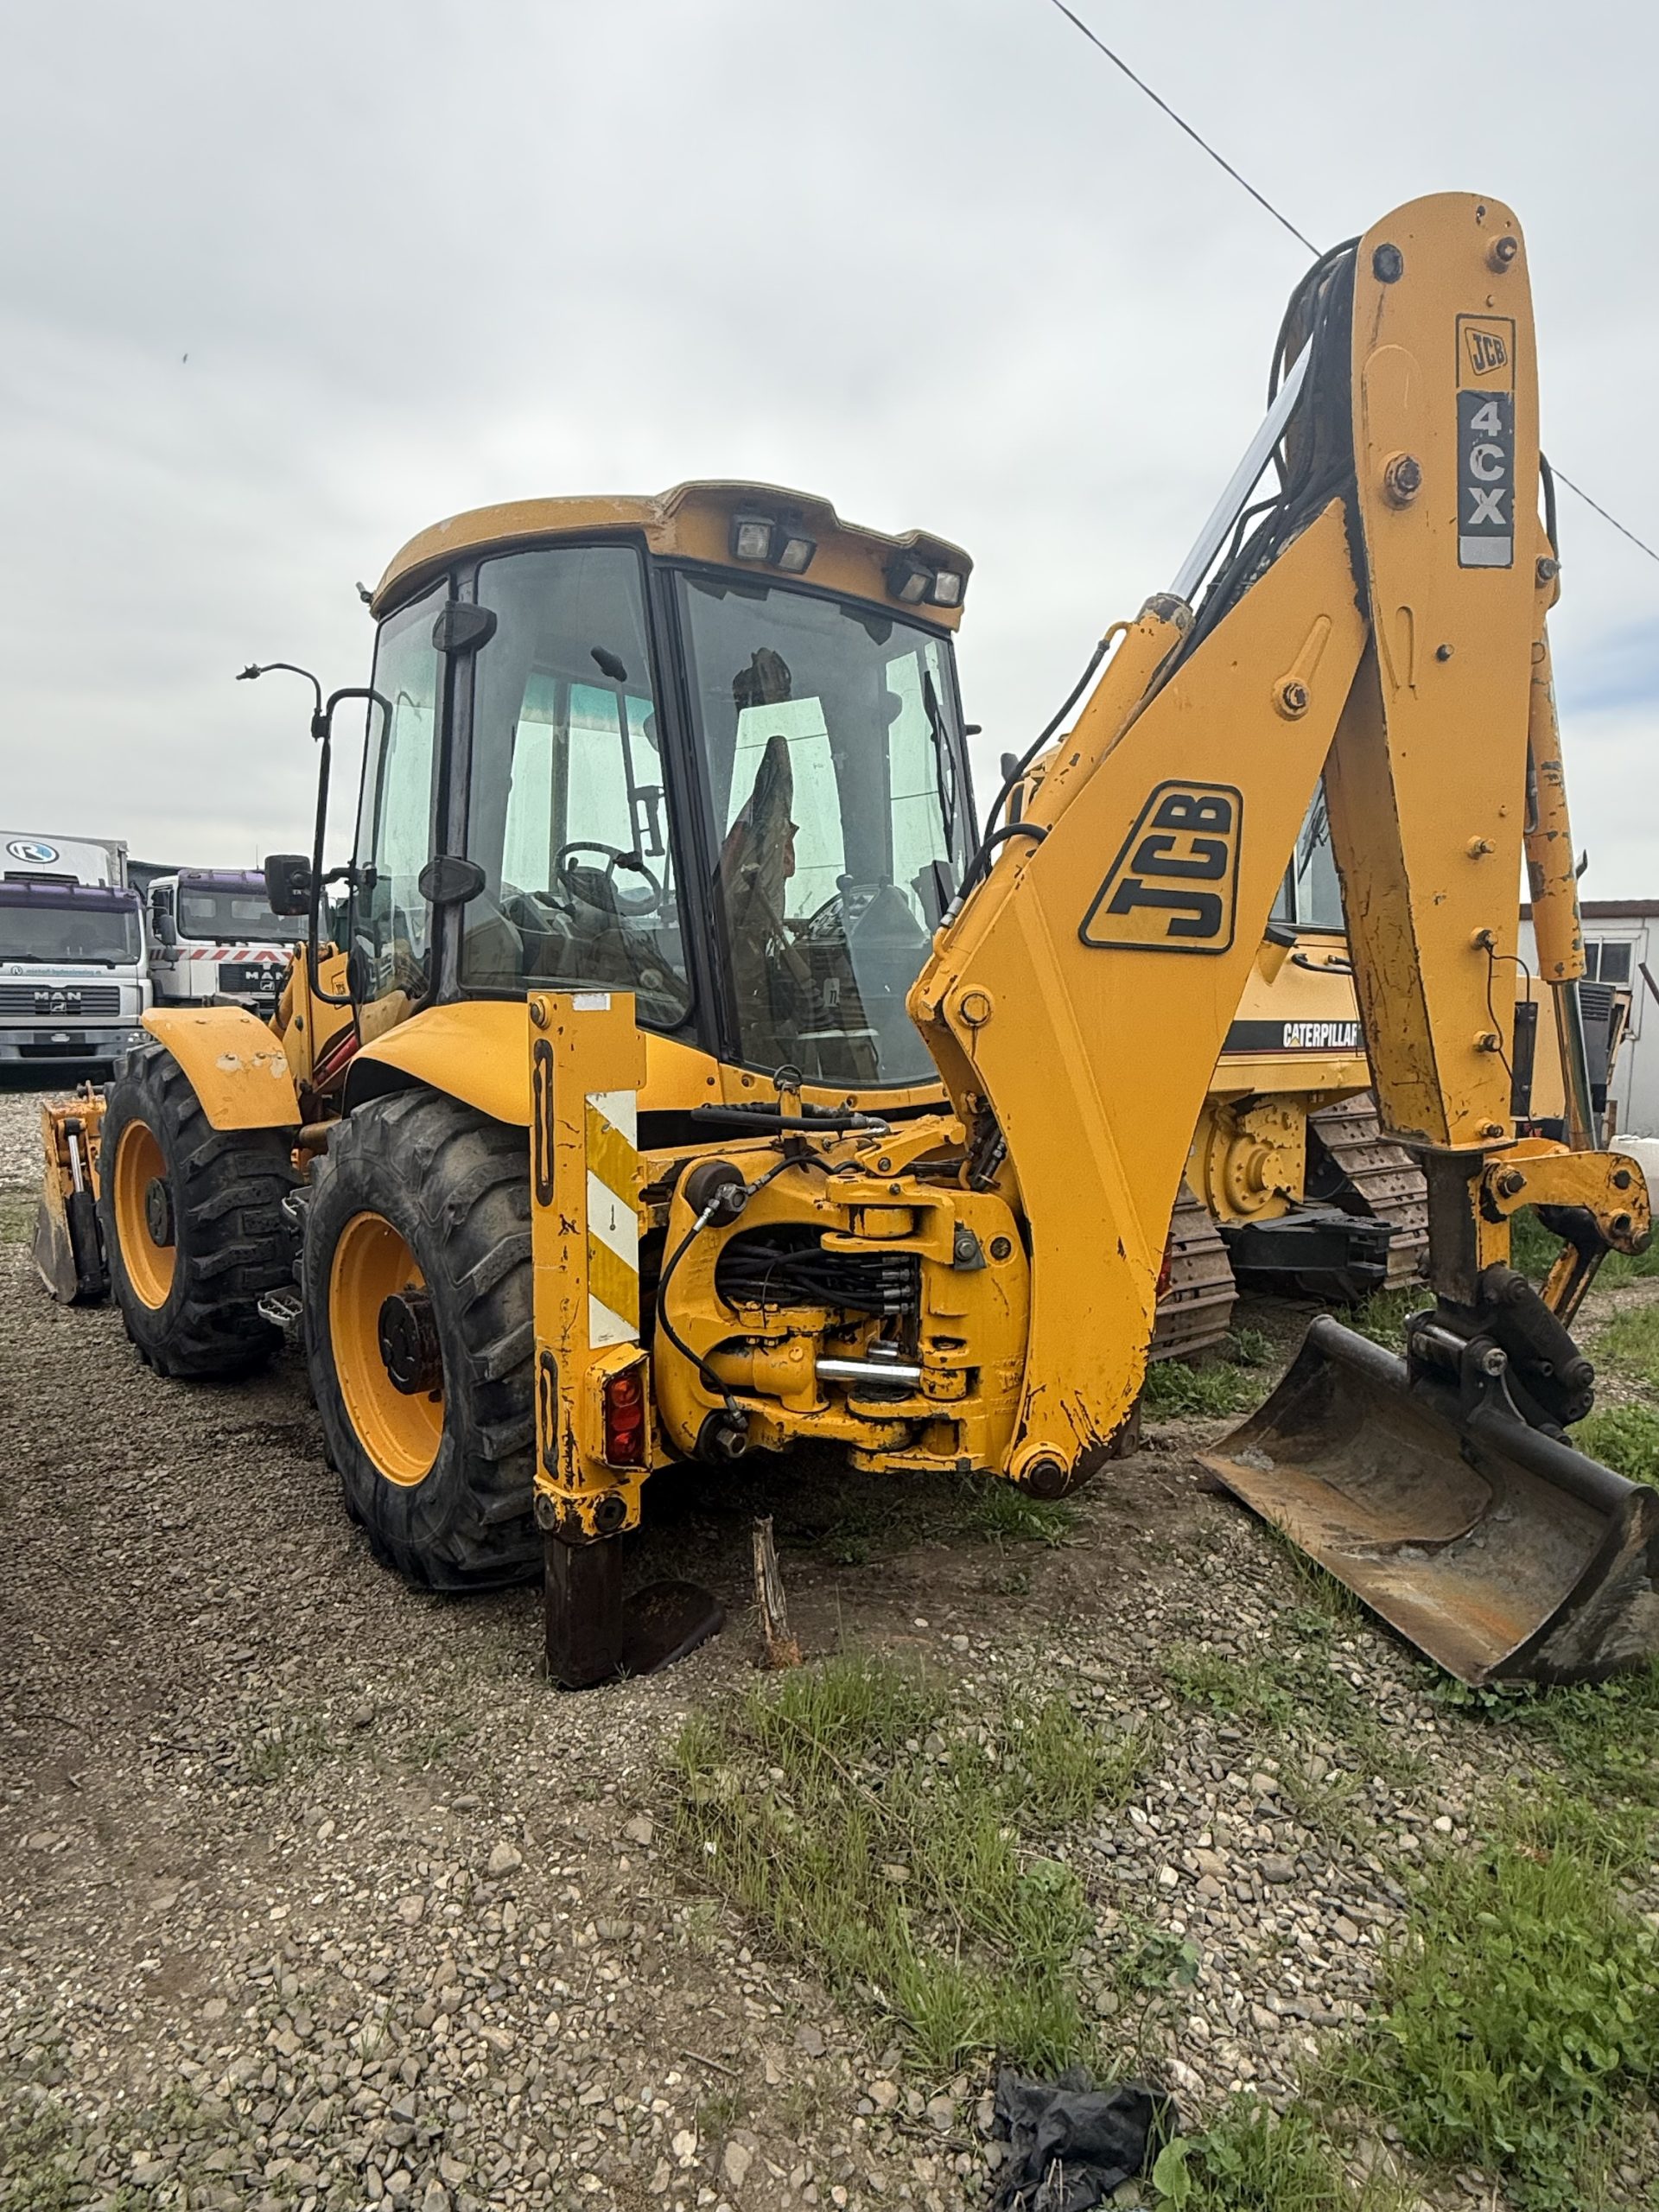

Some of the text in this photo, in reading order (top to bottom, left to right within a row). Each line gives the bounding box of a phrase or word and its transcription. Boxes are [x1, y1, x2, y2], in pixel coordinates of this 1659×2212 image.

[1472, 333, 1504, 371] JCB
[1468, 401, 1507, 524] 4CX
[1106, 794, 1232, 938] JCB
[35, 991, 81, 1001] MAN
[1283, 1023, 1357, 1048] CATERPILLAR
